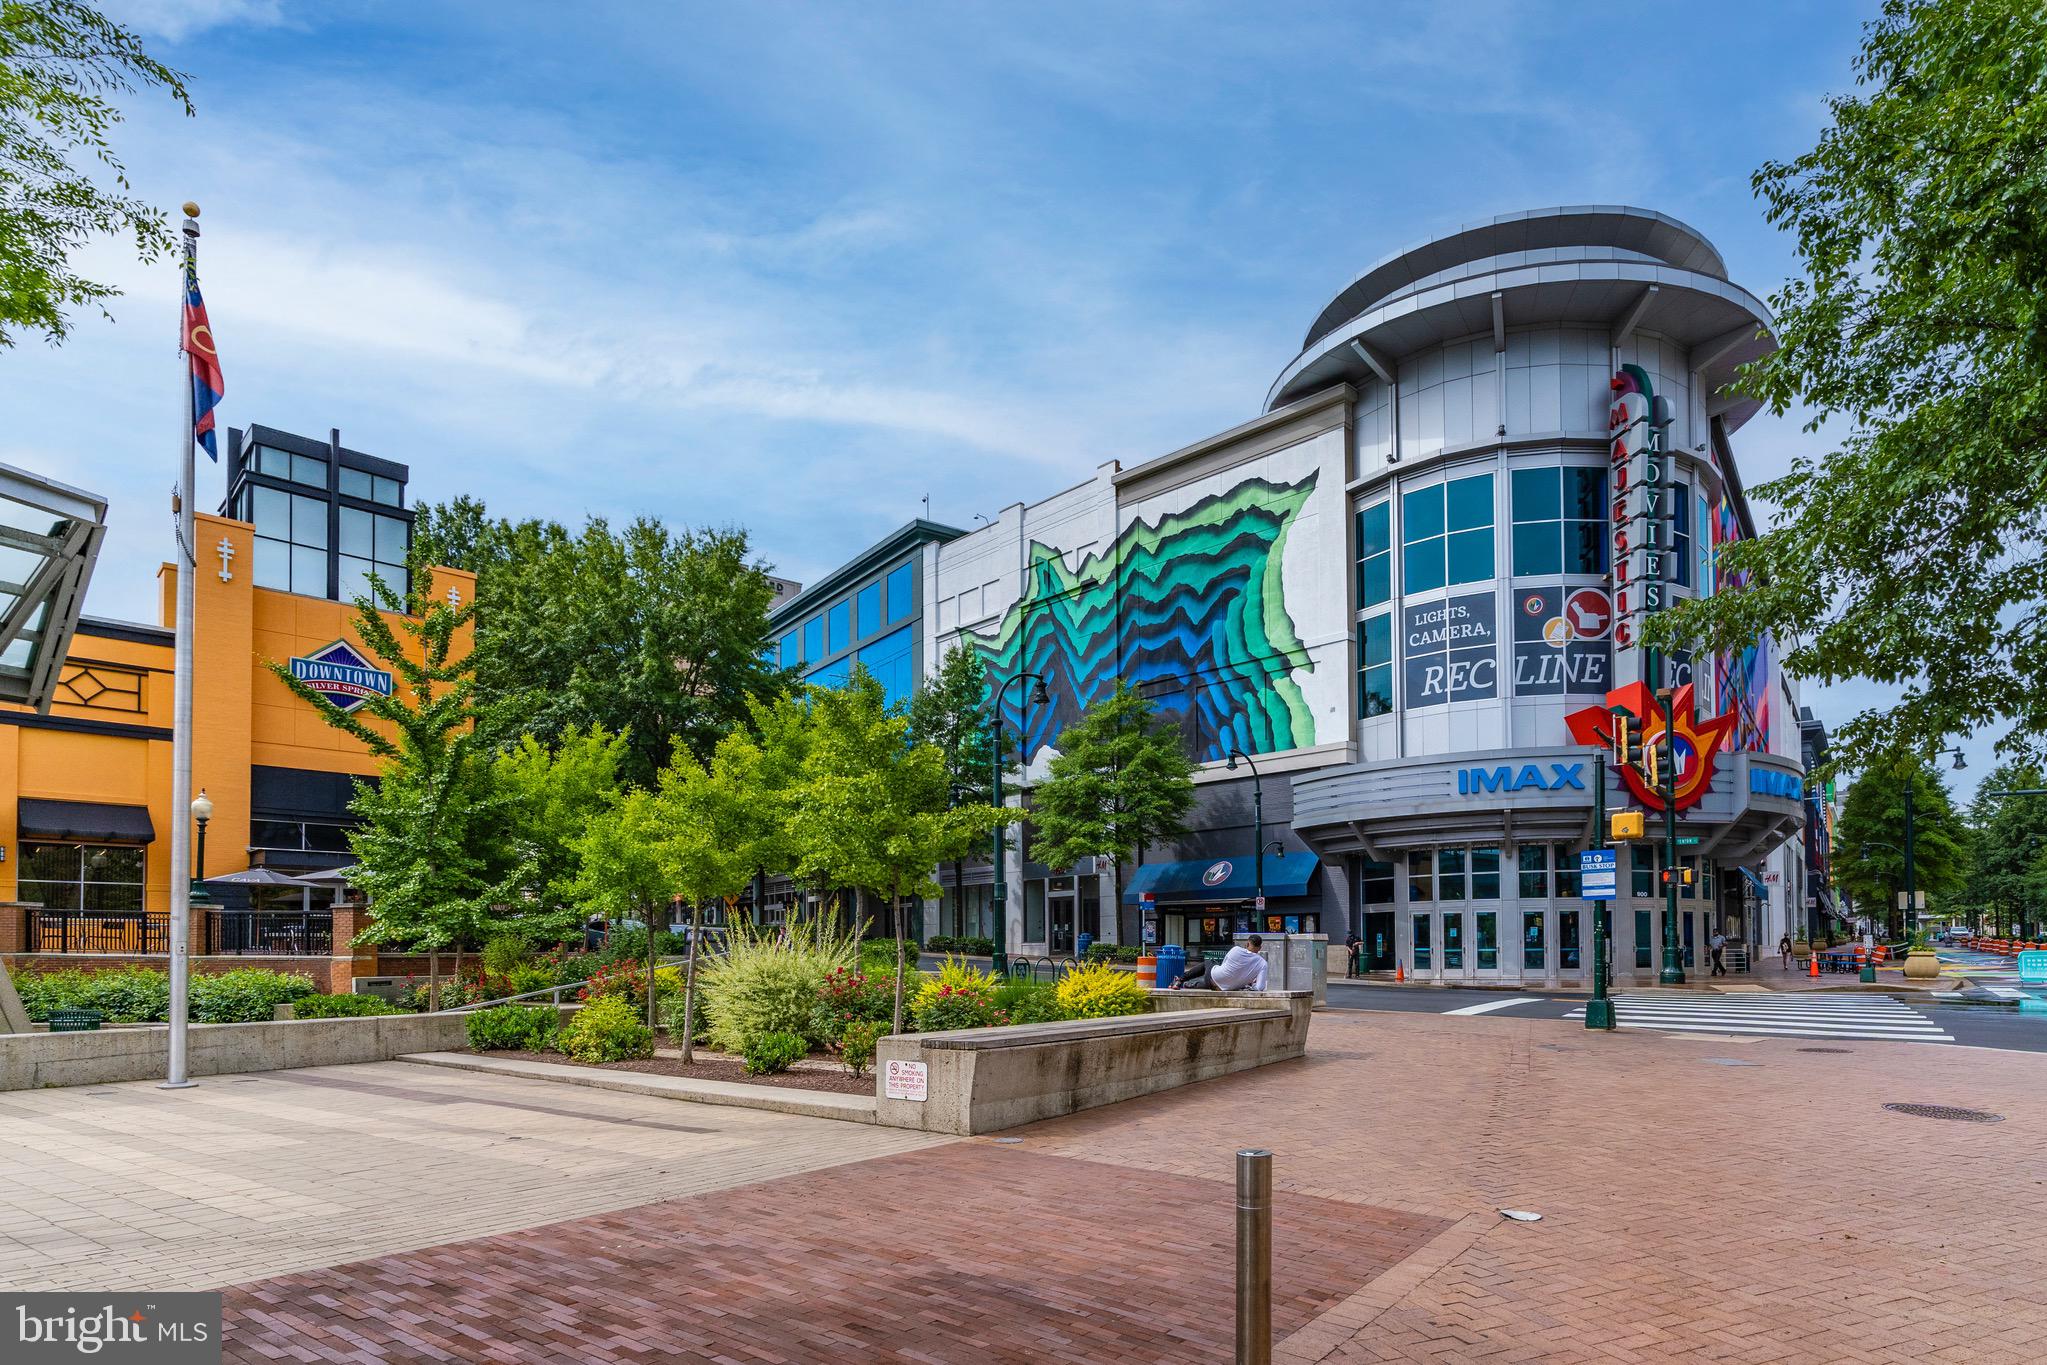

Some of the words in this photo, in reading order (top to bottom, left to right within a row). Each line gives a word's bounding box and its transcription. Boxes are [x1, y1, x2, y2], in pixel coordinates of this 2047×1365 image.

[1610, 402, 1631, 643] MAJESTIC
[1646, 433, 1660, 606] MOVIES
[1414, 606, 1470, 626] LIGHTS,
[1409, 622, 1491, 647] CAMERA,
[296, 661, 388, 692] DOWNTOWN
[307, 681, 340, 690] SILVER
[1458, 763, 1585, 795] IMAX
